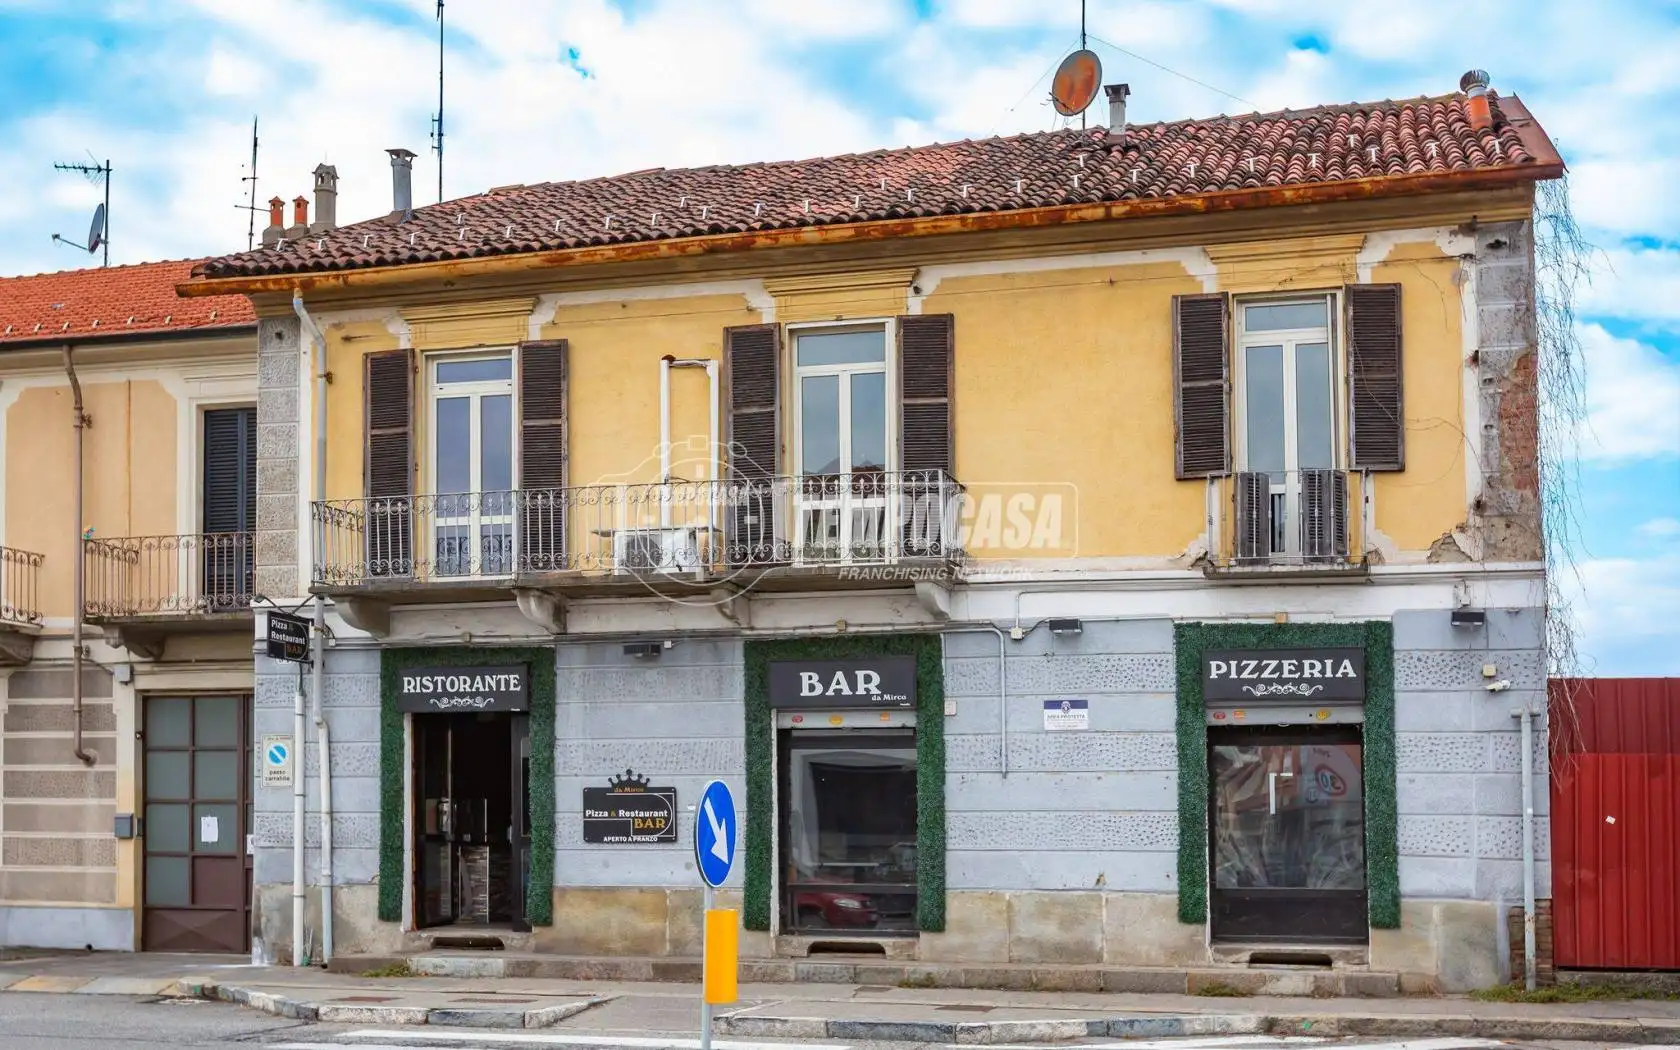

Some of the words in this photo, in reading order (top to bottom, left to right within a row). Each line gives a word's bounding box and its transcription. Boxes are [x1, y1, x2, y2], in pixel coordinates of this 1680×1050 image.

[271, 619, 288, 630] Pizza
[271, 631, 305, 645] Restaurant
[1209, 659, 1357, 680] PIZZERIA
[402, 674, 521, 693] RISTORANTE
[800, 670, 882, 696] BAR
[585, 809, 609, 817] Pizza
[618, 809, 668, 817] Restaurant
[634, 818, 666, 829] BAR
